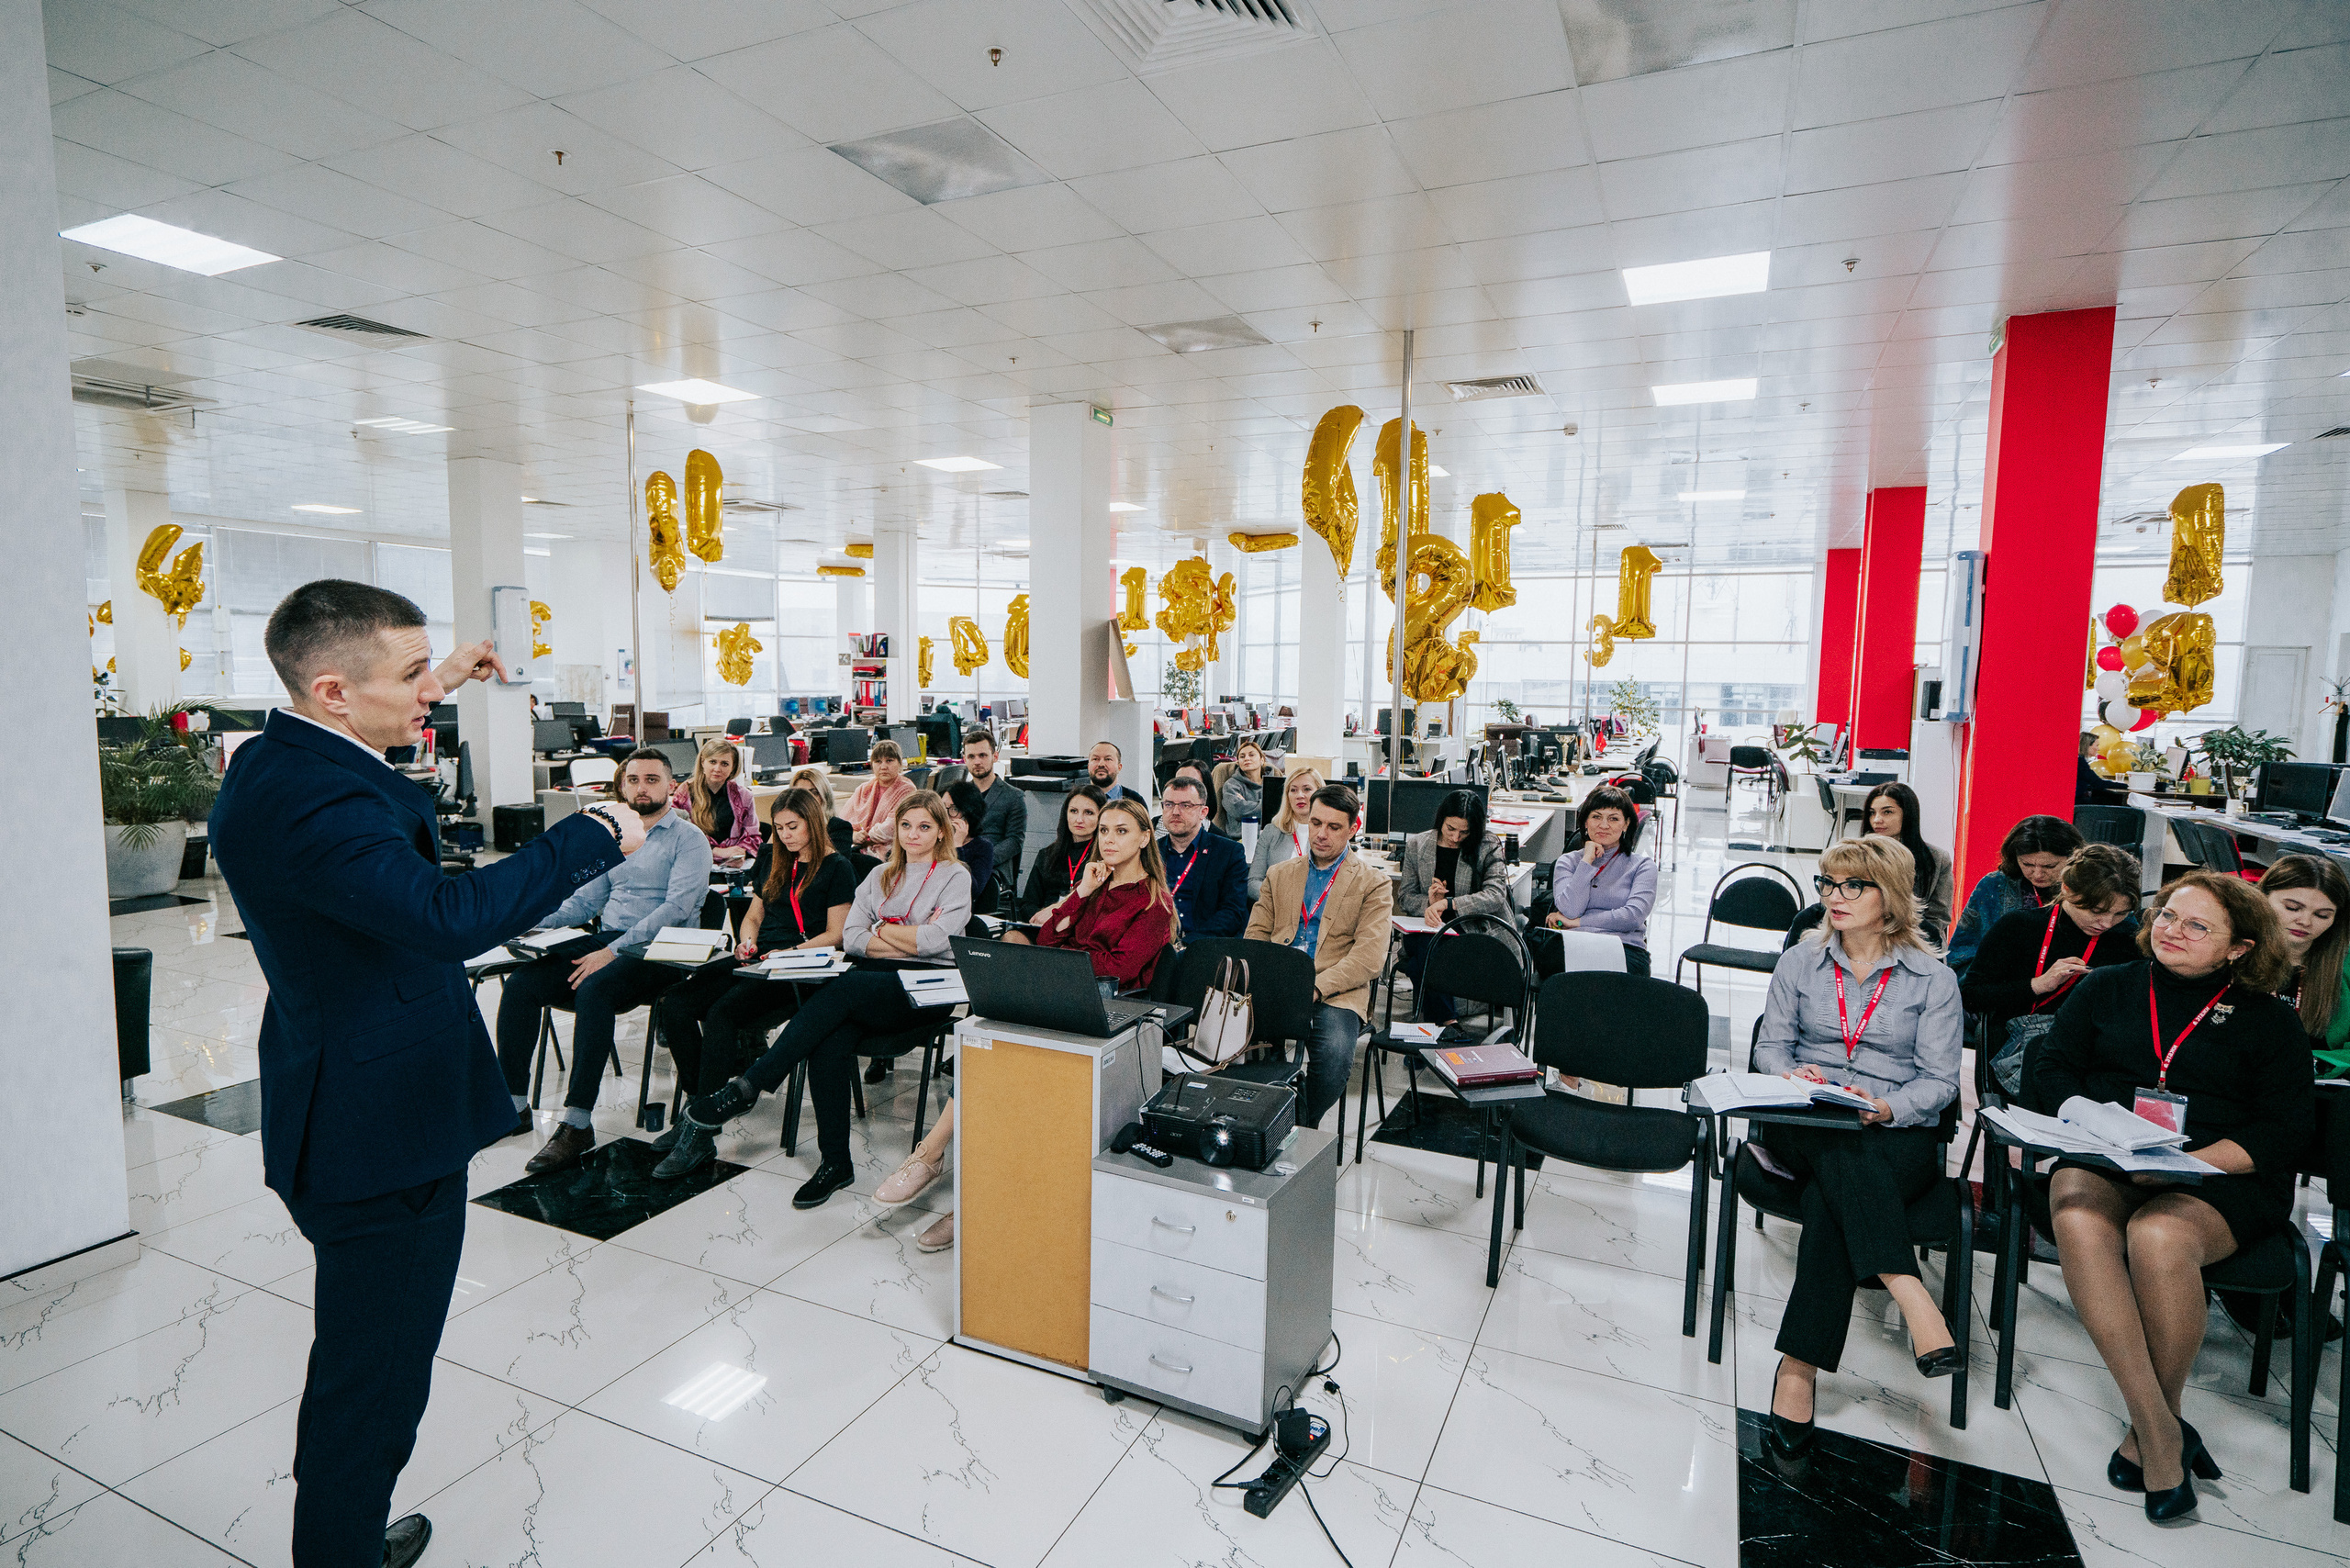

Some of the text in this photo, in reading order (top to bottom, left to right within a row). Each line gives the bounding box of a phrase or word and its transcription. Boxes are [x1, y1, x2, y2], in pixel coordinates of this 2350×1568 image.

[968, 949, 991, 958] Lenovo
[2197, 1006, 2210, 1022] ЭТАЖИ
[2165, 1045, 2177, 1064] ЭТАЖИ
